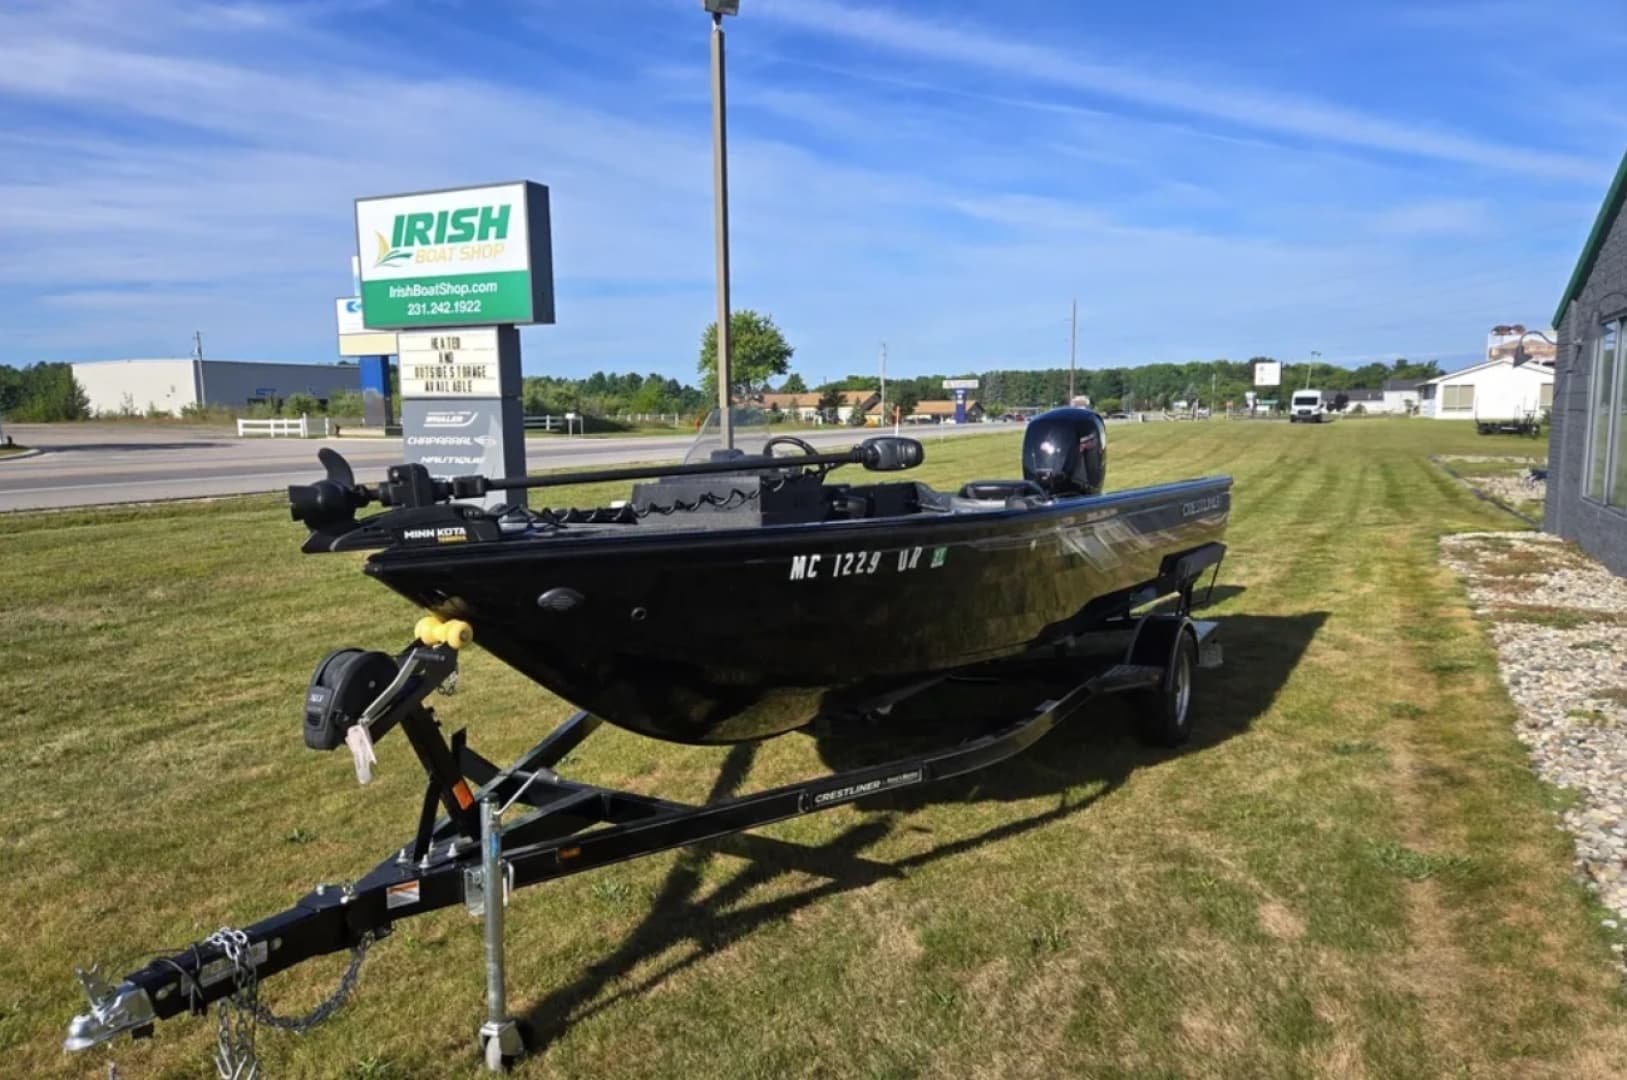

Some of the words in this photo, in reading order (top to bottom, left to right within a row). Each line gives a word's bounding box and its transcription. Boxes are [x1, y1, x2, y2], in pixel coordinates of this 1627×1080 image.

[391, 204, 511, 248] IRISH
[415, 246, 455, 264] BOAT
[459, 243, 505, 261] SHOP
[389, 282, 498, 298] IrishBoatShop.com
[407, 300, 482, 316] 231.242.1922
[425, 380, 472, 393] AVAILABLE
[403, 528, 435, 540] MINN
[437, 527, 467, 536] KOTA
[789, 554, 822, 581] MC
[832, 551, 882, 578] 1229
[814, 779, 882, 804] CRESTLINER
